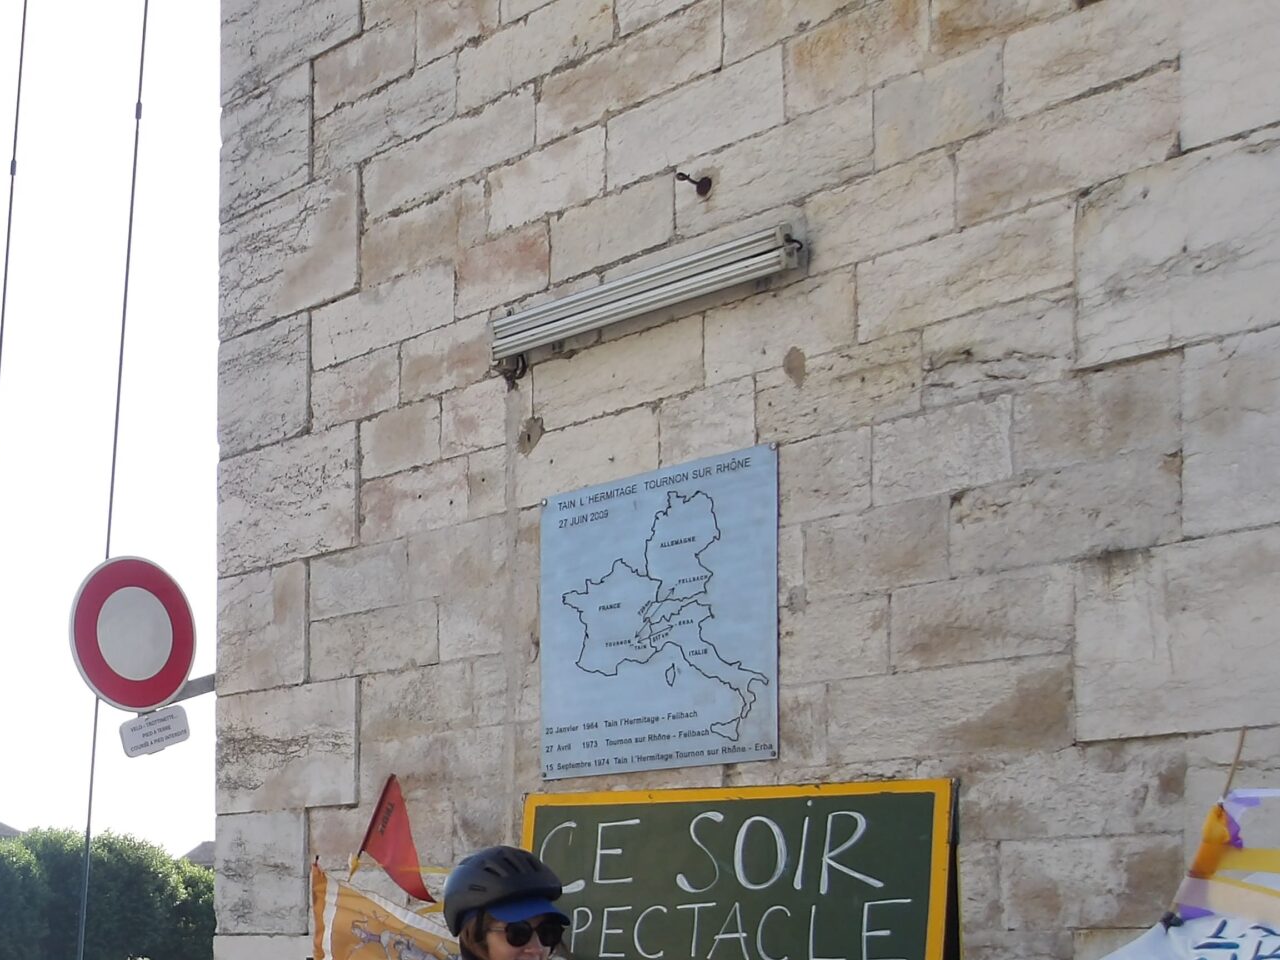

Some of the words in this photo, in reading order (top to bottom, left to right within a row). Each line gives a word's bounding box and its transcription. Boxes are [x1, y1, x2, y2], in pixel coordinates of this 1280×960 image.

[557, 500, 576, 512] TAIN
[644, 472, 689, 491] TOURNON
[692, 466, 712, 479] SUR
[716, 457, 752, 474] RHÔNE
[558, 519, 569, 529] 27
[570, 514, 588, 527] JUIN
[660, 536, 696, 548] ALLEMAGNE
[678, 575, 708, 584] FELLBACH
[598, 602, 621, 611] FRANCE
[555, 725, 579, 734] Janvier
[604, 719, 618, 728] Tain
[667, 710, 697, 720] Fellbach
[545, 745, 554, 753] 27
[557, 743, 571, 752] Avril
[582, 740, 598, 749] 1973
[605, 737, 633, 746] Tournon
[648, 732, 671, 742] Rhône
[678, 728, 710, 738] Fellbach
[545, 763, 554, 771] 15
[557, 760, 591, 771] Septembre
[594, 758, 610, 767] 1974
[614, 757, 628, 765] Tain
[675, 749, 705, 758] Tournon
[707, 748, 719, 756] sur
[721, 745, 746, 754] Rhône
[754, 743, 773, 752] Erba
[540, 818, 640, 895] CE
